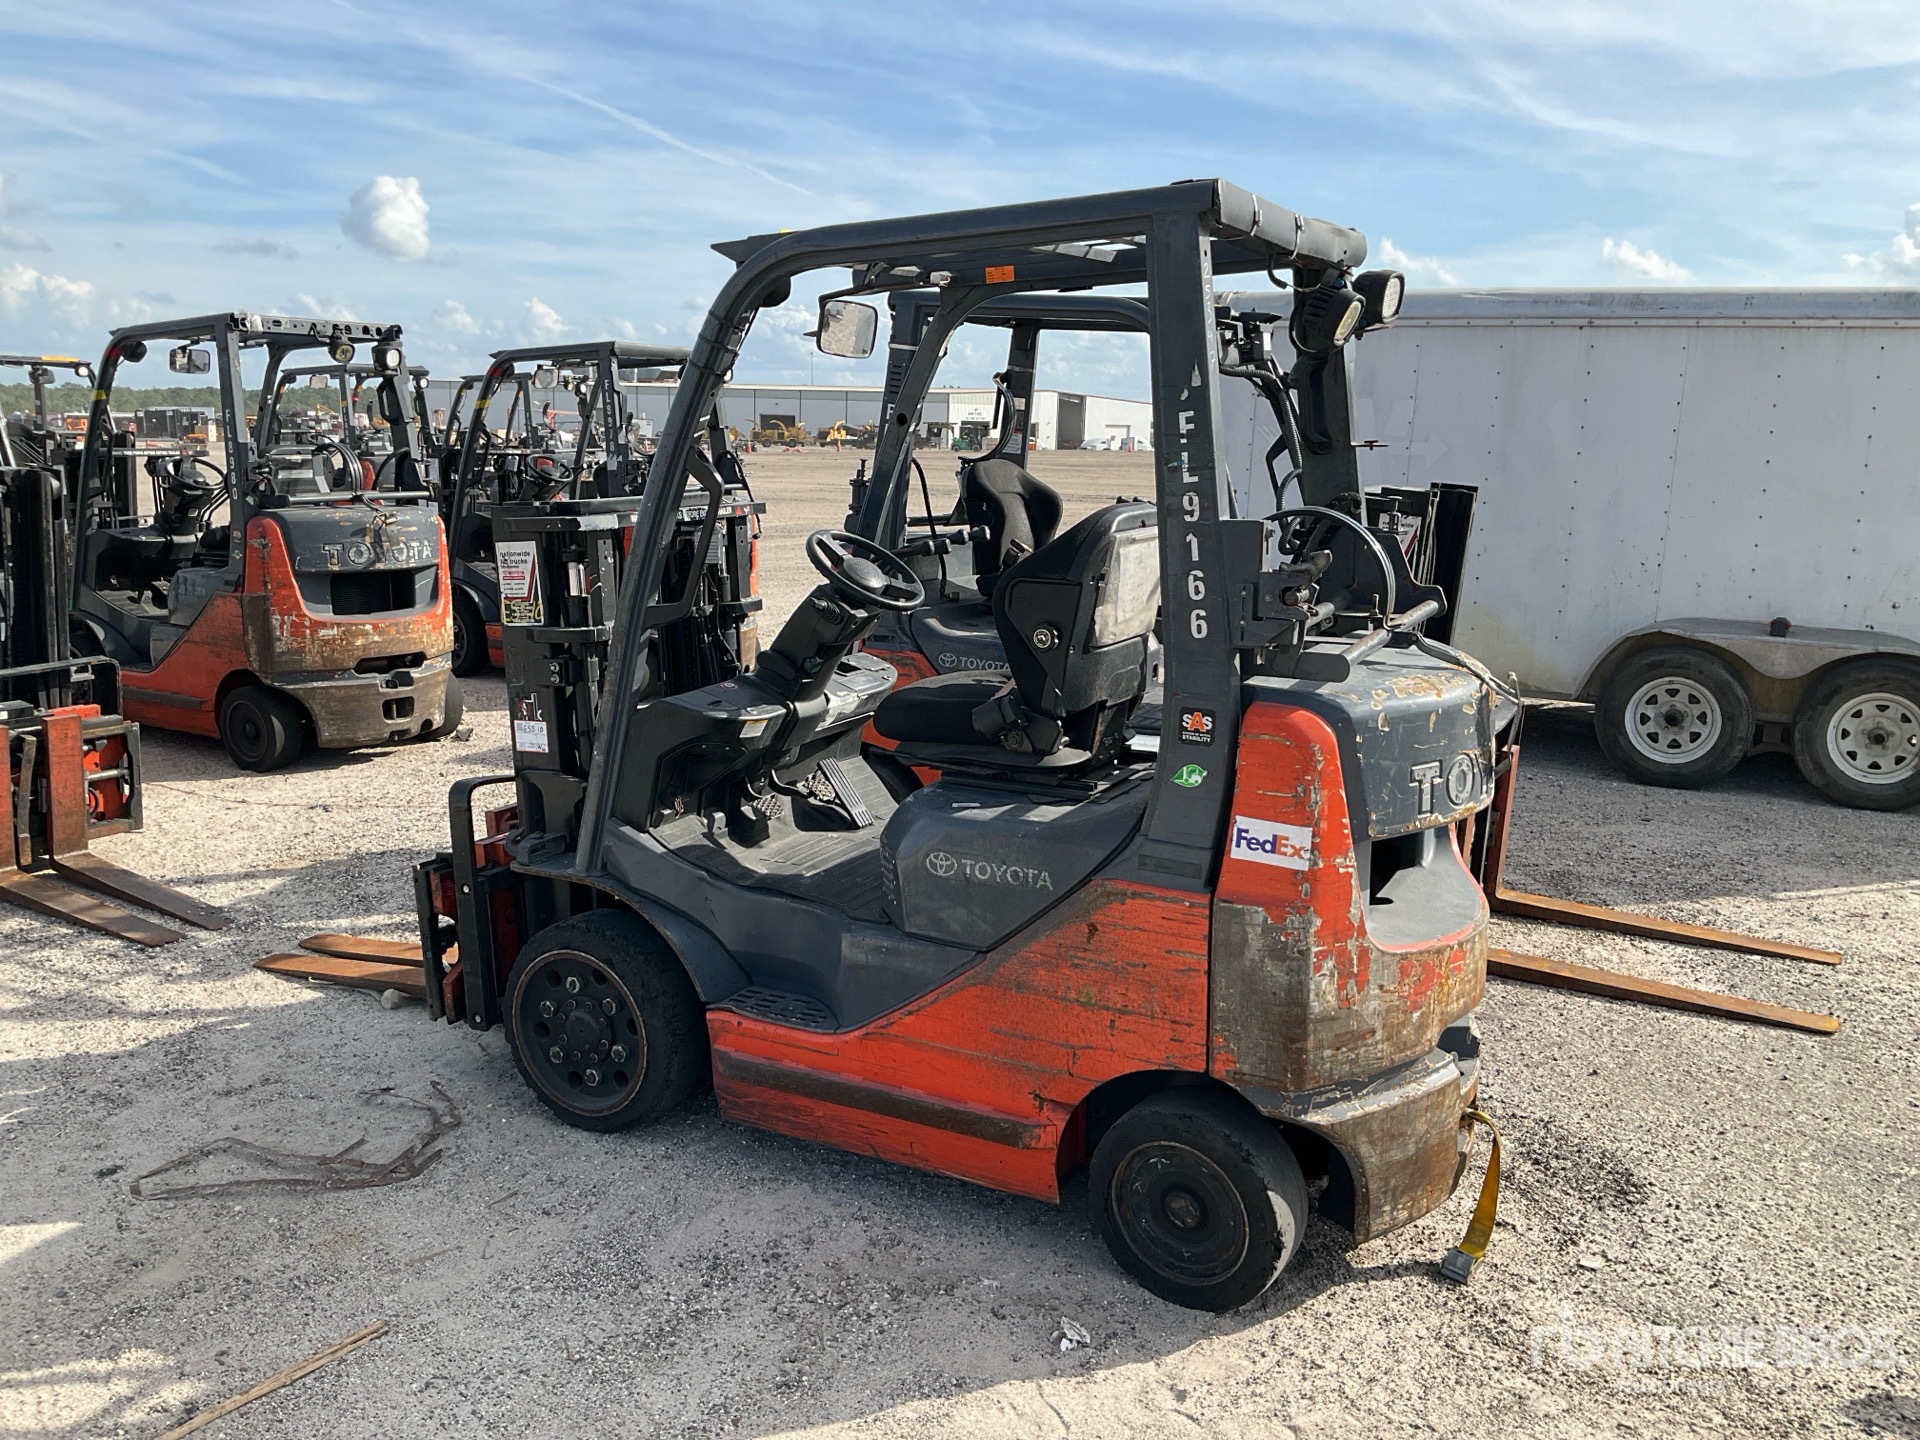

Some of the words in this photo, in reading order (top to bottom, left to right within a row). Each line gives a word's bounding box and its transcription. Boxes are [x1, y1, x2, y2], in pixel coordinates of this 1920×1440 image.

[1178, 410, 1208, 639] FL9166
[1182, 712, 1213, 732] SAS
[1182, 734, 1211, 743] STABILITY
[1235, 827, 1307, 860] FedEx
[961, 858, 1053, 891] TOYOTA
